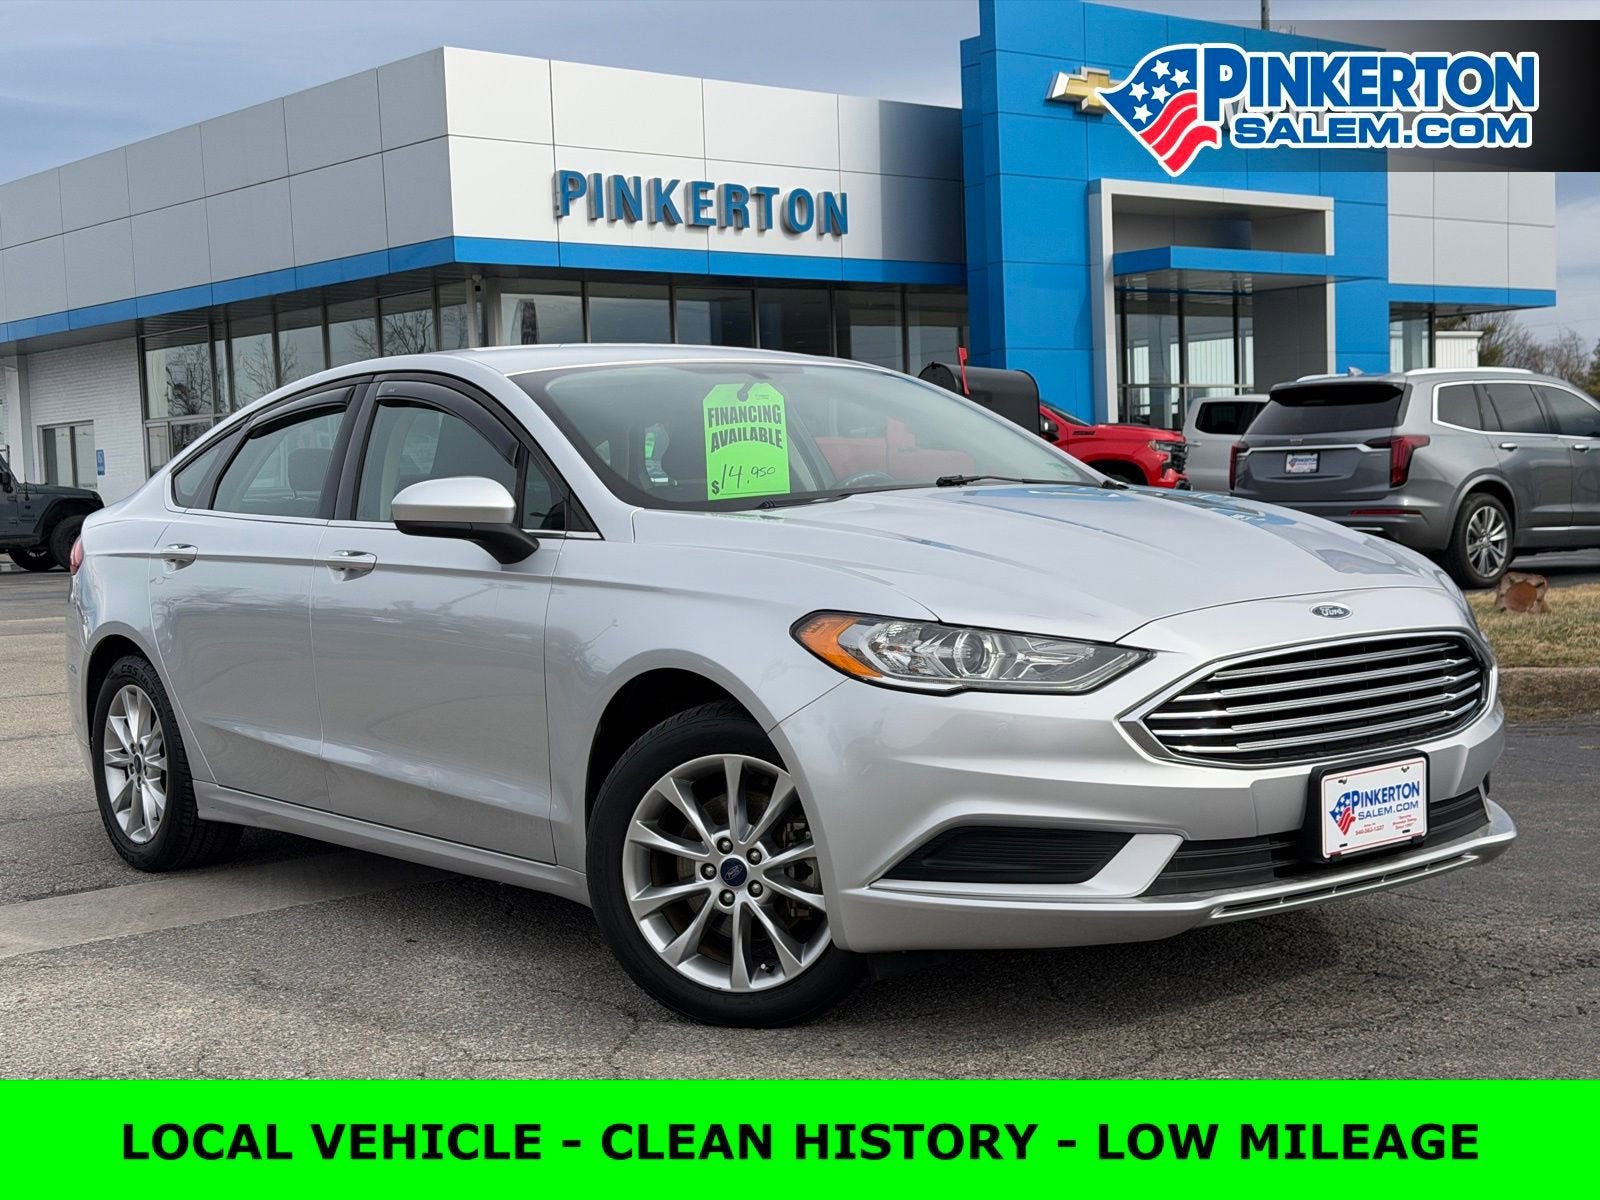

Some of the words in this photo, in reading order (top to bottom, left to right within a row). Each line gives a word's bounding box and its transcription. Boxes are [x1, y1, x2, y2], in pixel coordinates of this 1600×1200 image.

[553, 169, 849, 236] PINKERTON
[707, 404, 782, 428] FINANCING
[710, 426, 784, 453] AVAILABLE
[1351, 780, 1420, 814] PINKERTON
[1357, 800, 1419, 821] SALEM.COM
